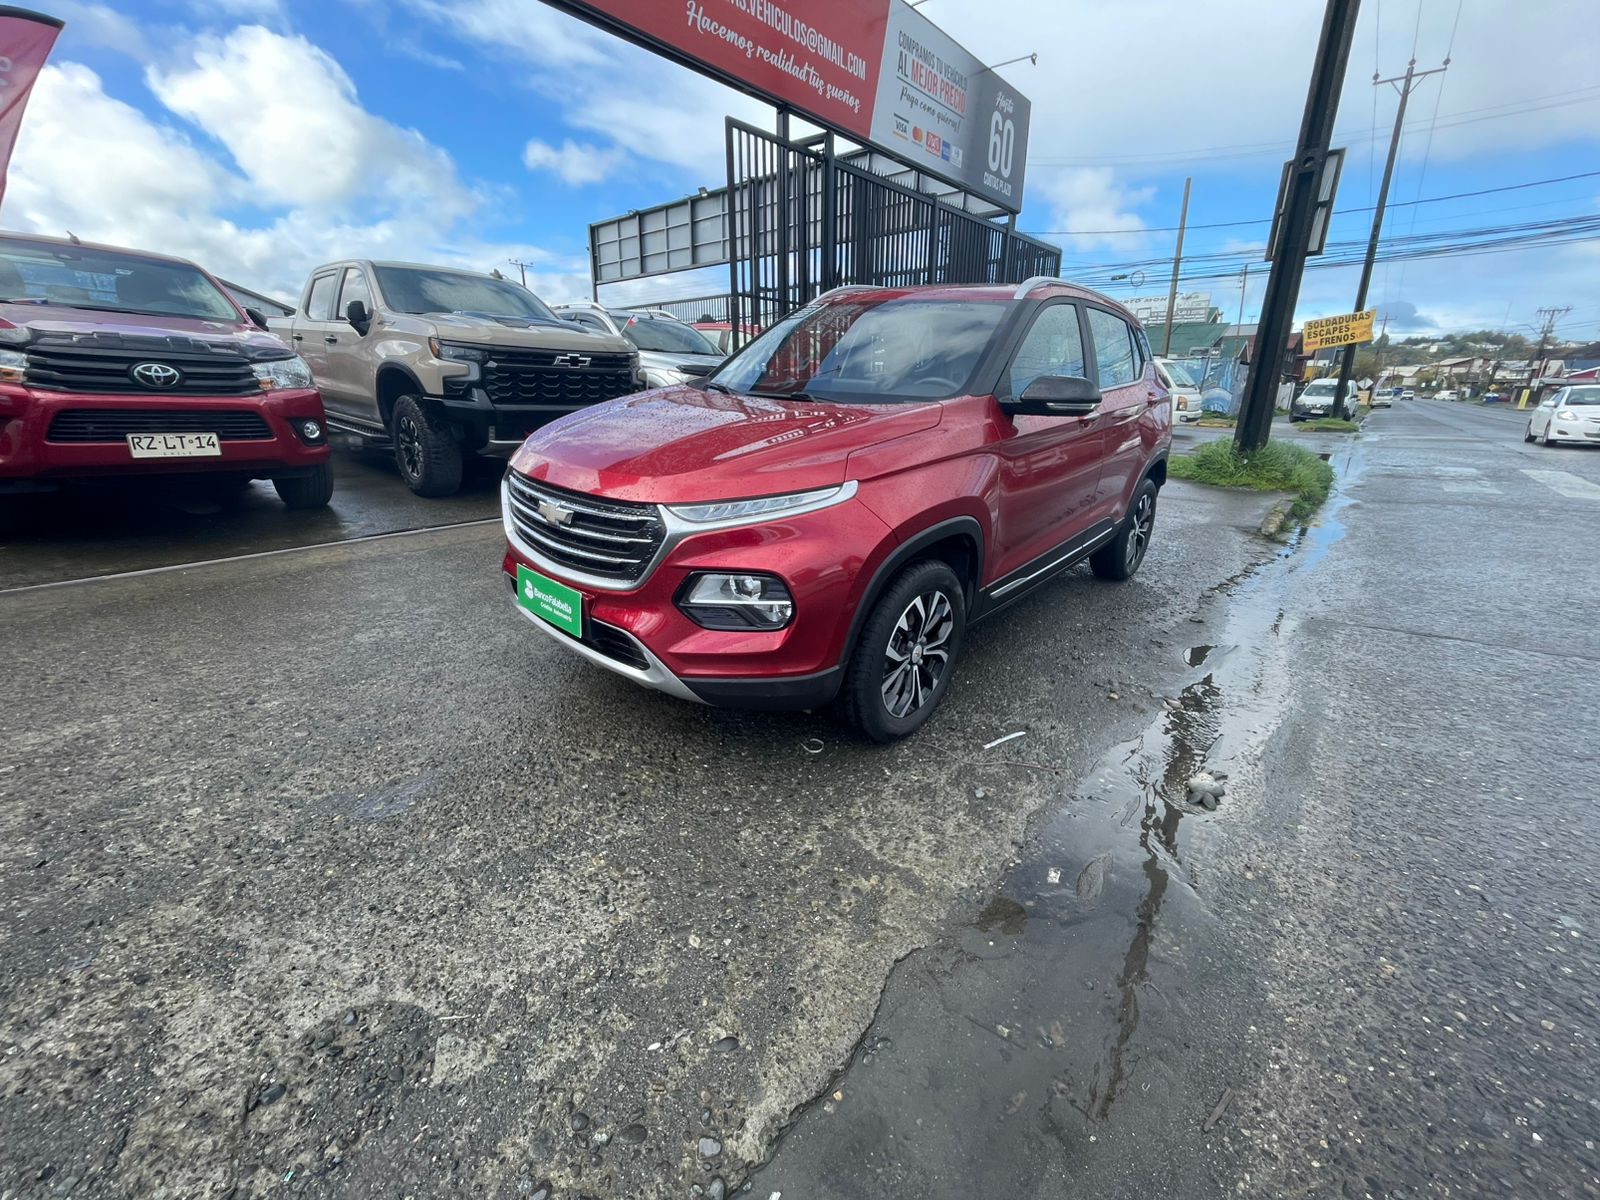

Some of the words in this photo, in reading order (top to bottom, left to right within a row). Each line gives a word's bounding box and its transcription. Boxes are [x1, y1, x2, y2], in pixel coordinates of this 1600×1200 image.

[686, 0, 754, 58] Hacemos
[756, 45, 808, 82] realidad
[806, 64, 825, 95] tus
[826, 83, 861, 113] sueños
[898, 30, 935, 70] COMPRAMOS
[936, 57, 943, 75] TU
[897, 50, 908, 78] AL
[911, 58, 938, 97] MEJOR
[939, 80, 966, 113] PRECIO
[920, 101, 936, 117] como
[995, 91, 1014, 114] Hasta
[895, 120, 907, 134] VISA
[988, 110, 1015, 178] 60
[983, 171, 999, 190] CUOTAS
[999, 179, 1012, 197] PLAZO
[1307, 311, 1371, 331] SOLDADURAS
[1307, 324, 1350, 339] ESCAPES
[1320, 332, 1356, 346] FRENOS
